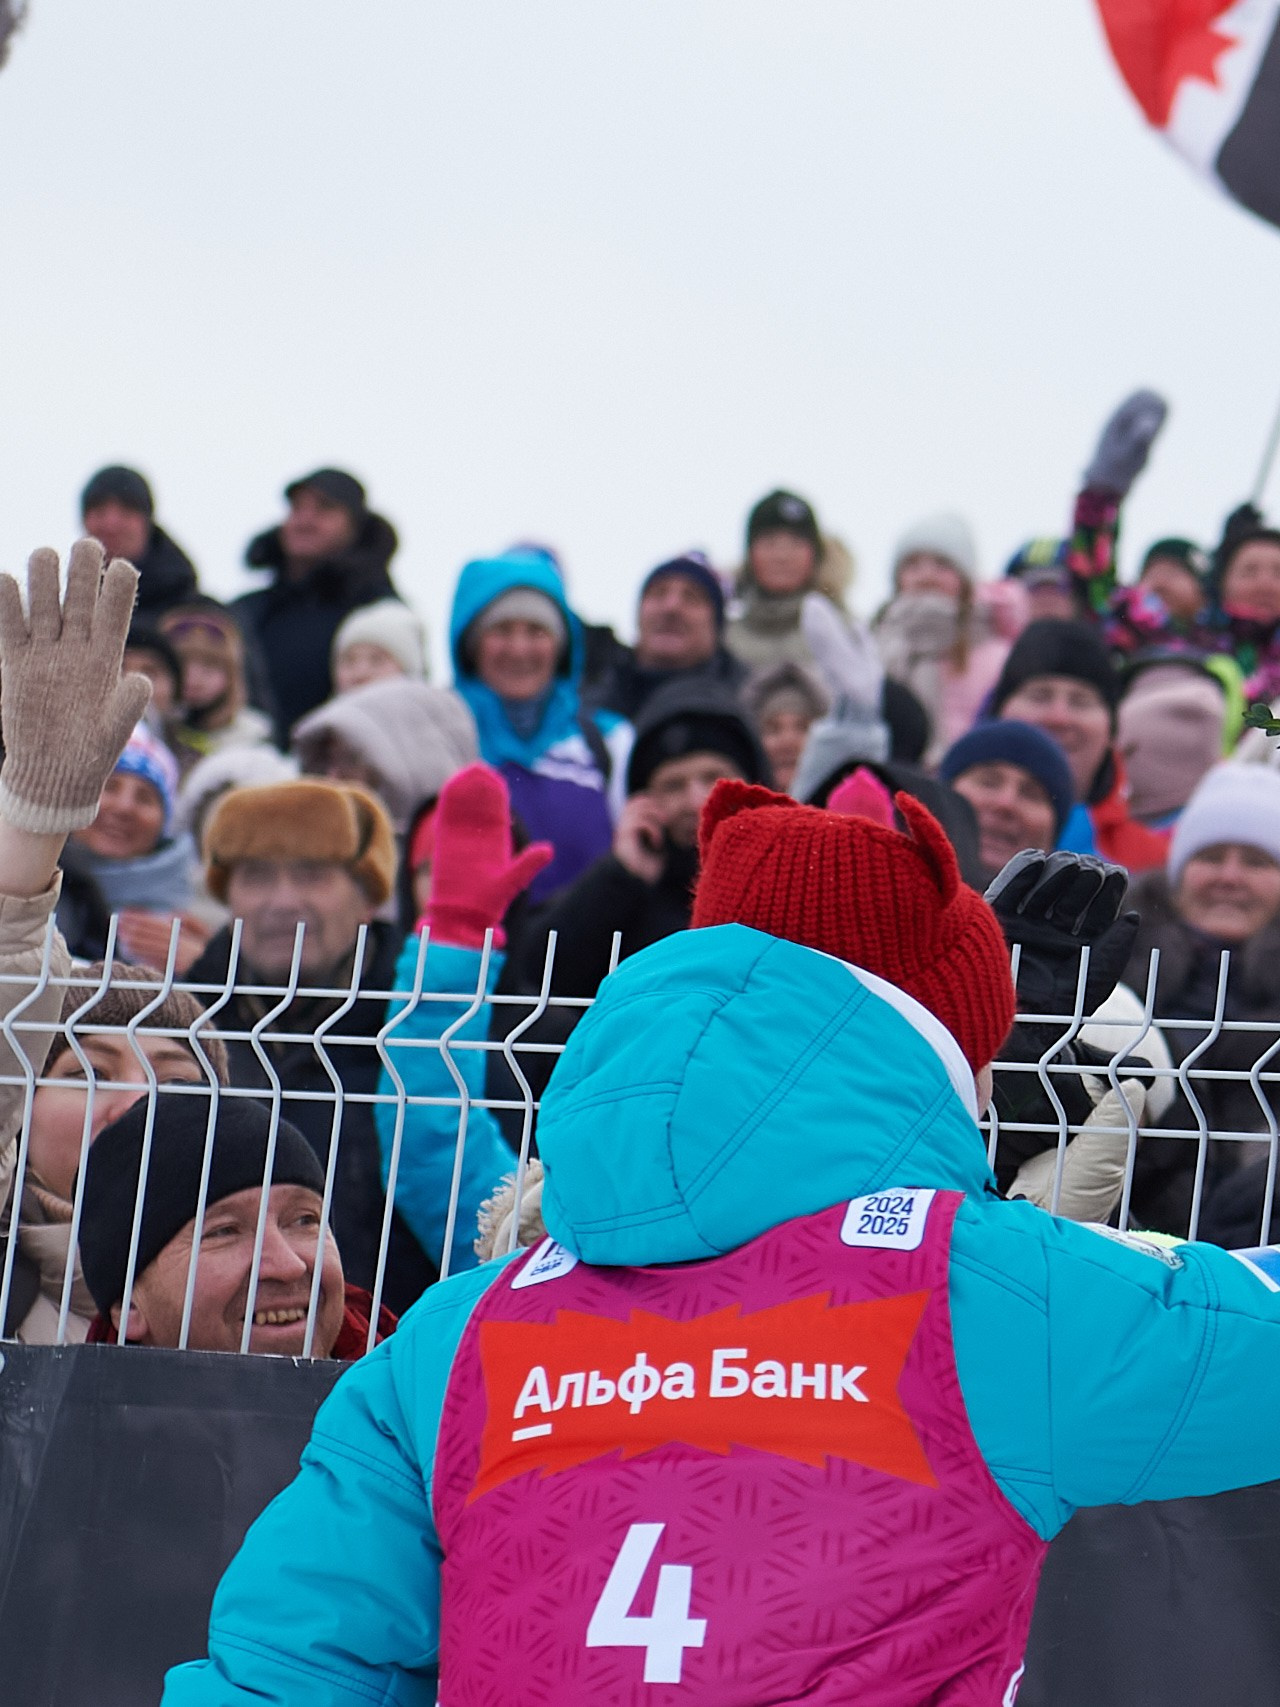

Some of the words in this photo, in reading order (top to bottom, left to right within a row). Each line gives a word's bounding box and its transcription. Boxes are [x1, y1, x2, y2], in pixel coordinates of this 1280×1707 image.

[857, 1214, 911, 1235] 2025
[863, 1196, 915, 1215] 2024
[512, 1352, 695, 1419] Альфа
[709, 1347, 870, 1403] Банк
[586, 1522, 708, 1684] 4
